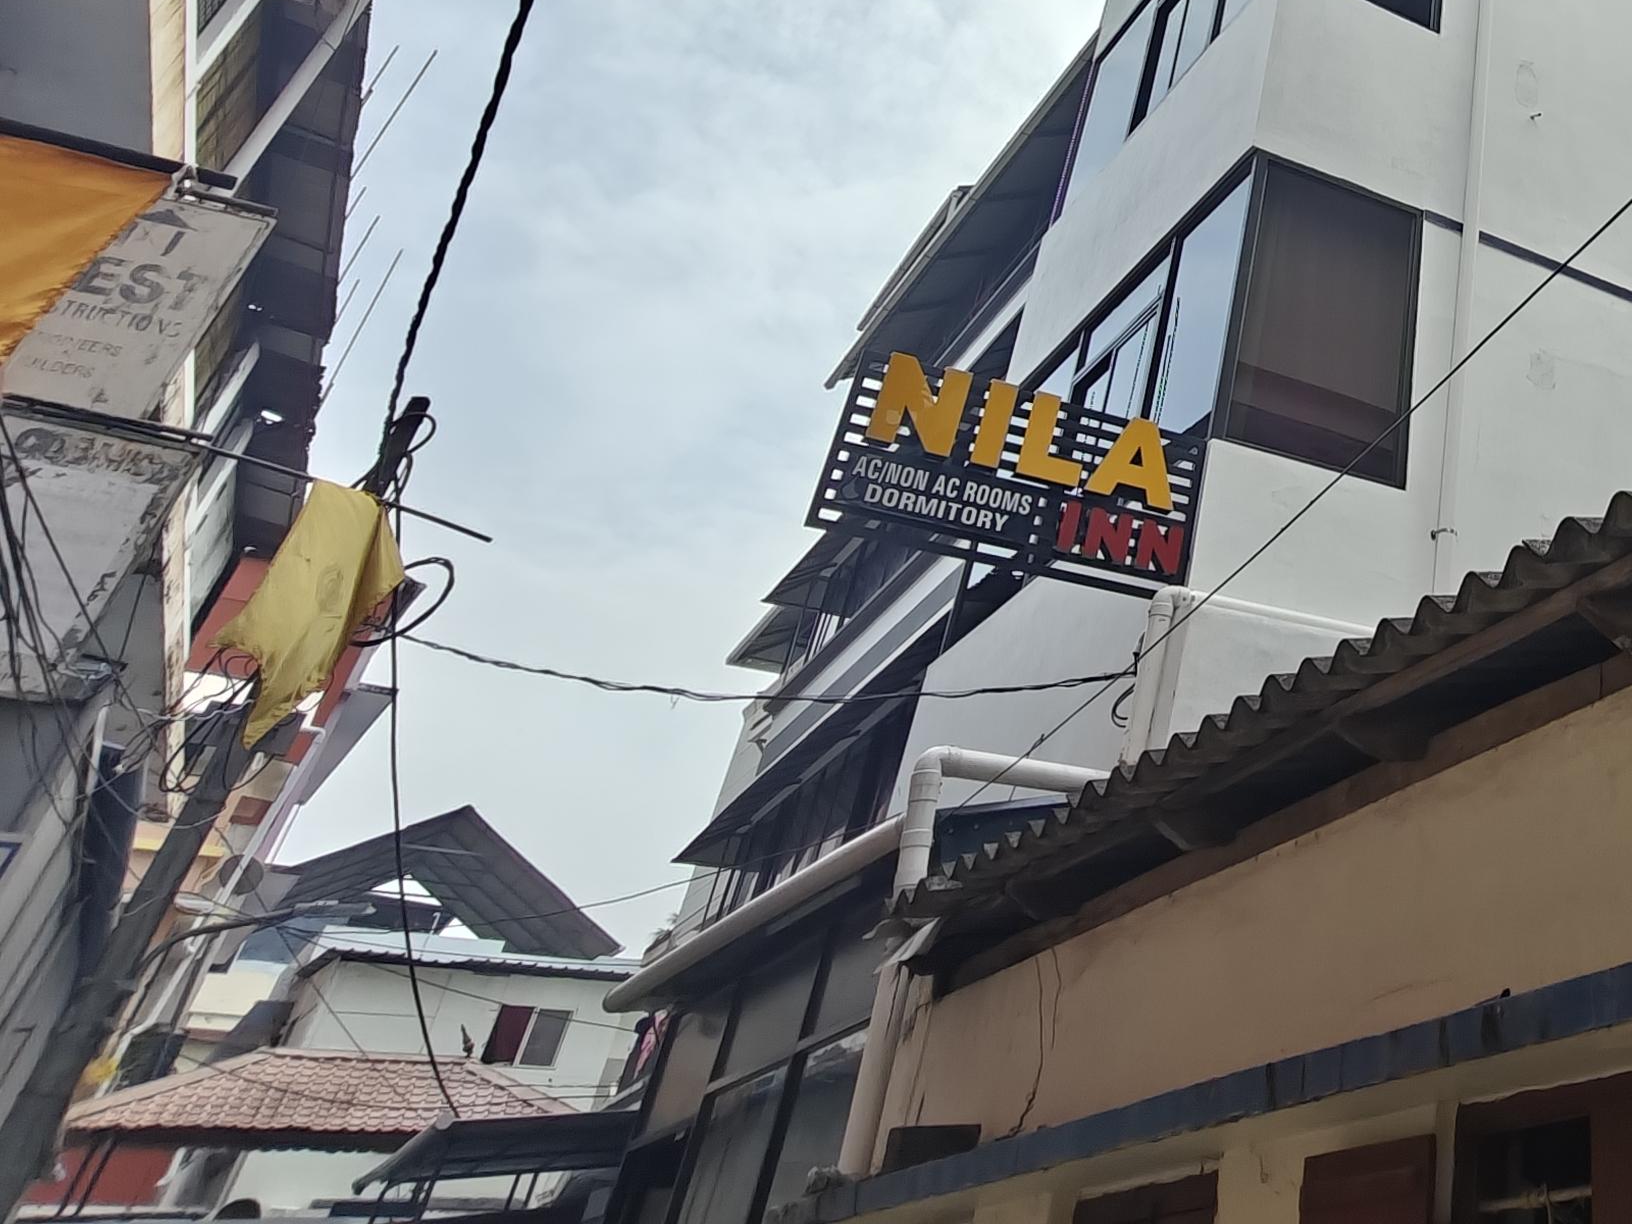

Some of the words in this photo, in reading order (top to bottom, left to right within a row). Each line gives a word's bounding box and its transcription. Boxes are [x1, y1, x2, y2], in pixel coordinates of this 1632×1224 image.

[865, 351, 1175, 511] NILA
[852, 455, 930, 492] AC/NON
[931, 474, 961, 499] AC
[963, 481, 1033, 516] ROOMS
[864, 483, 1010, 532] DORMITORY
[1054, 499, 1185, 576] INN
